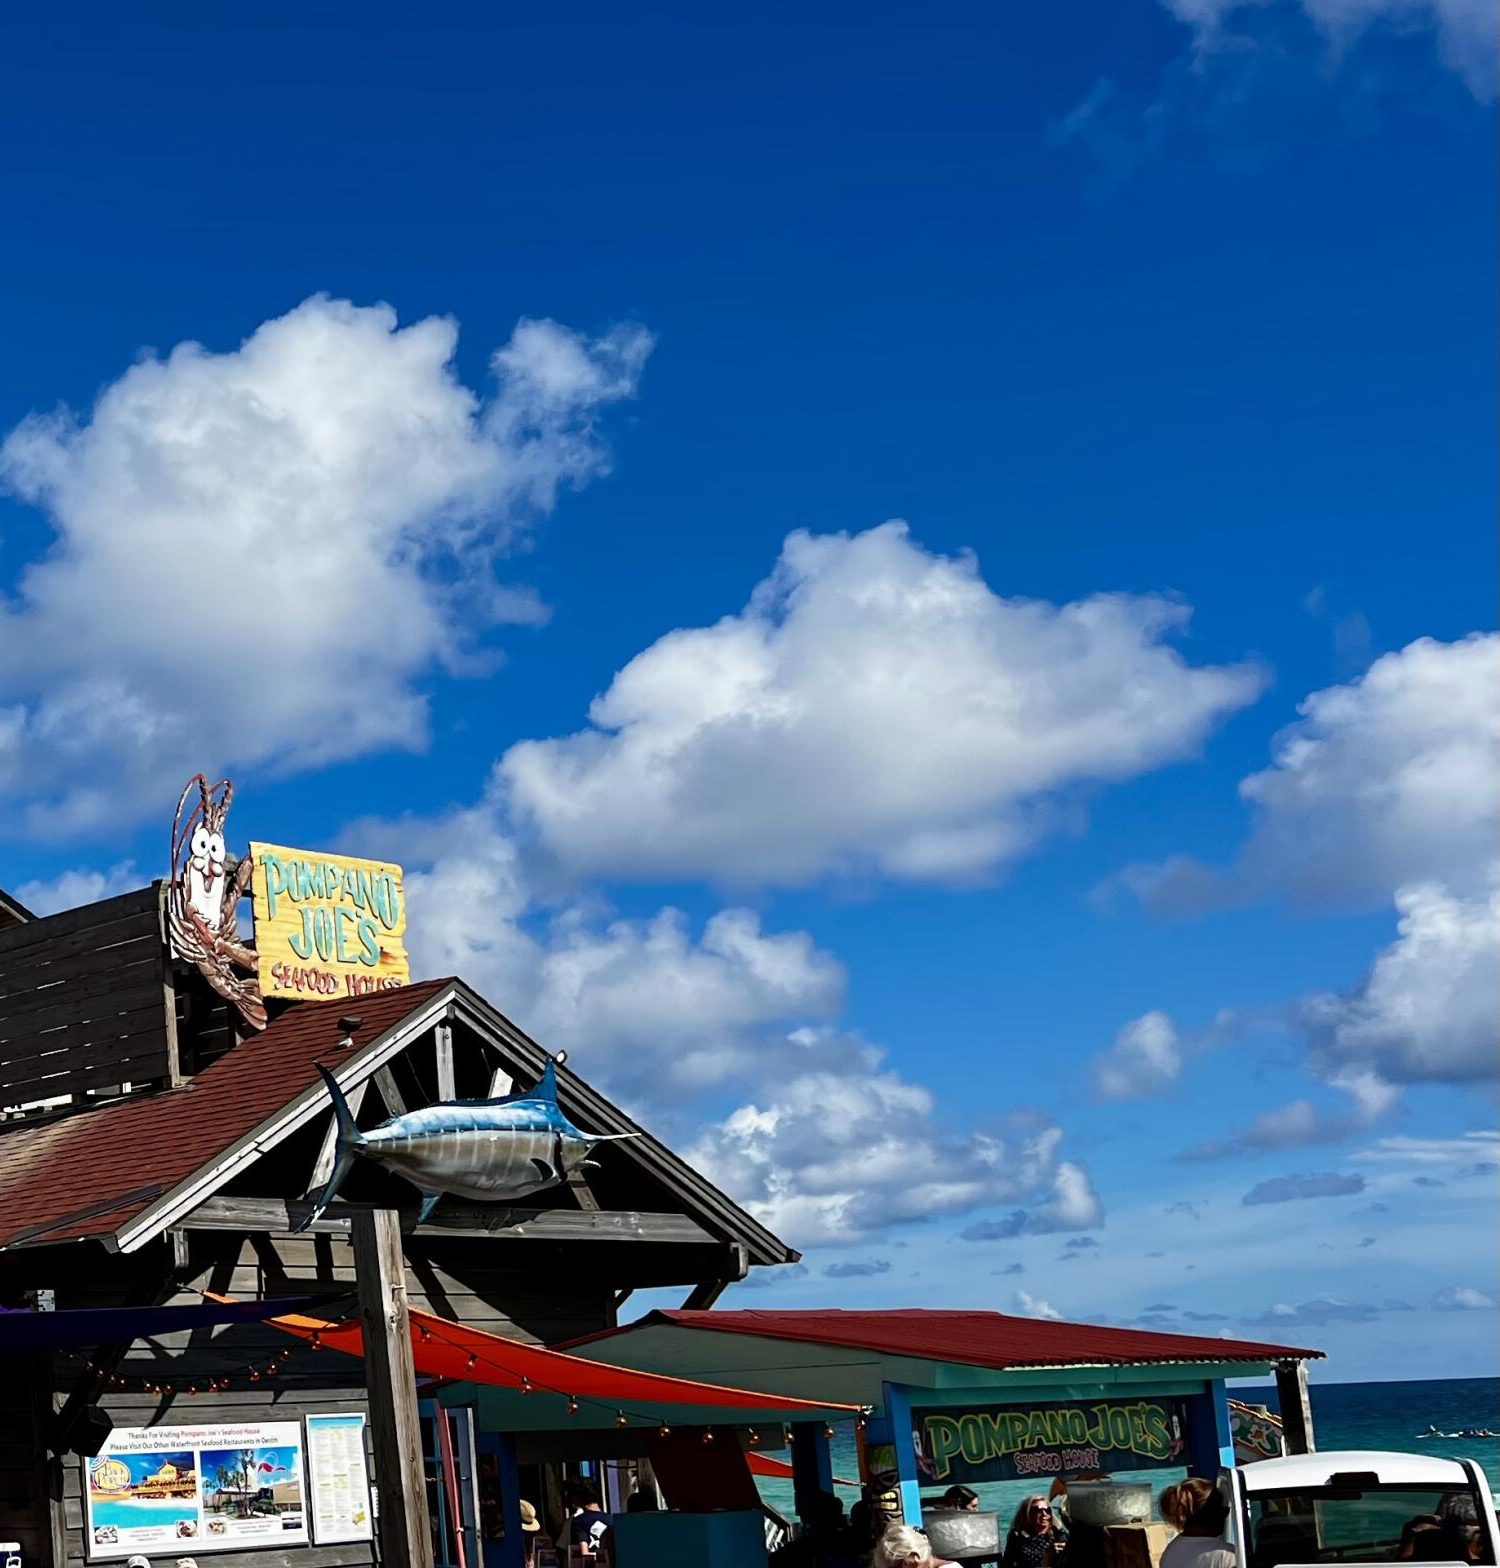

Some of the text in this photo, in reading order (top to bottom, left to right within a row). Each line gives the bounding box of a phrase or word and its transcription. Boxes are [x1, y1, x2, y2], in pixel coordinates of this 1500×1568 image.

[260, 855, 399, 930] POMPANO
[288, 907, 381, 966] JOE'S
[271, 962, 340, 994] SEAFOOD
[142, 1441, 153, 1449] Our
[153, 1441, 170, 1449] Other
[160, 1431, 180, 1439] Visiting
[925, 1411, 1088, 1480] POMPANO
[1088, 1402, 1172, 1460] JOE'S
[1013, 1447, 1102, 1475] SEAFOOD HOUSE
